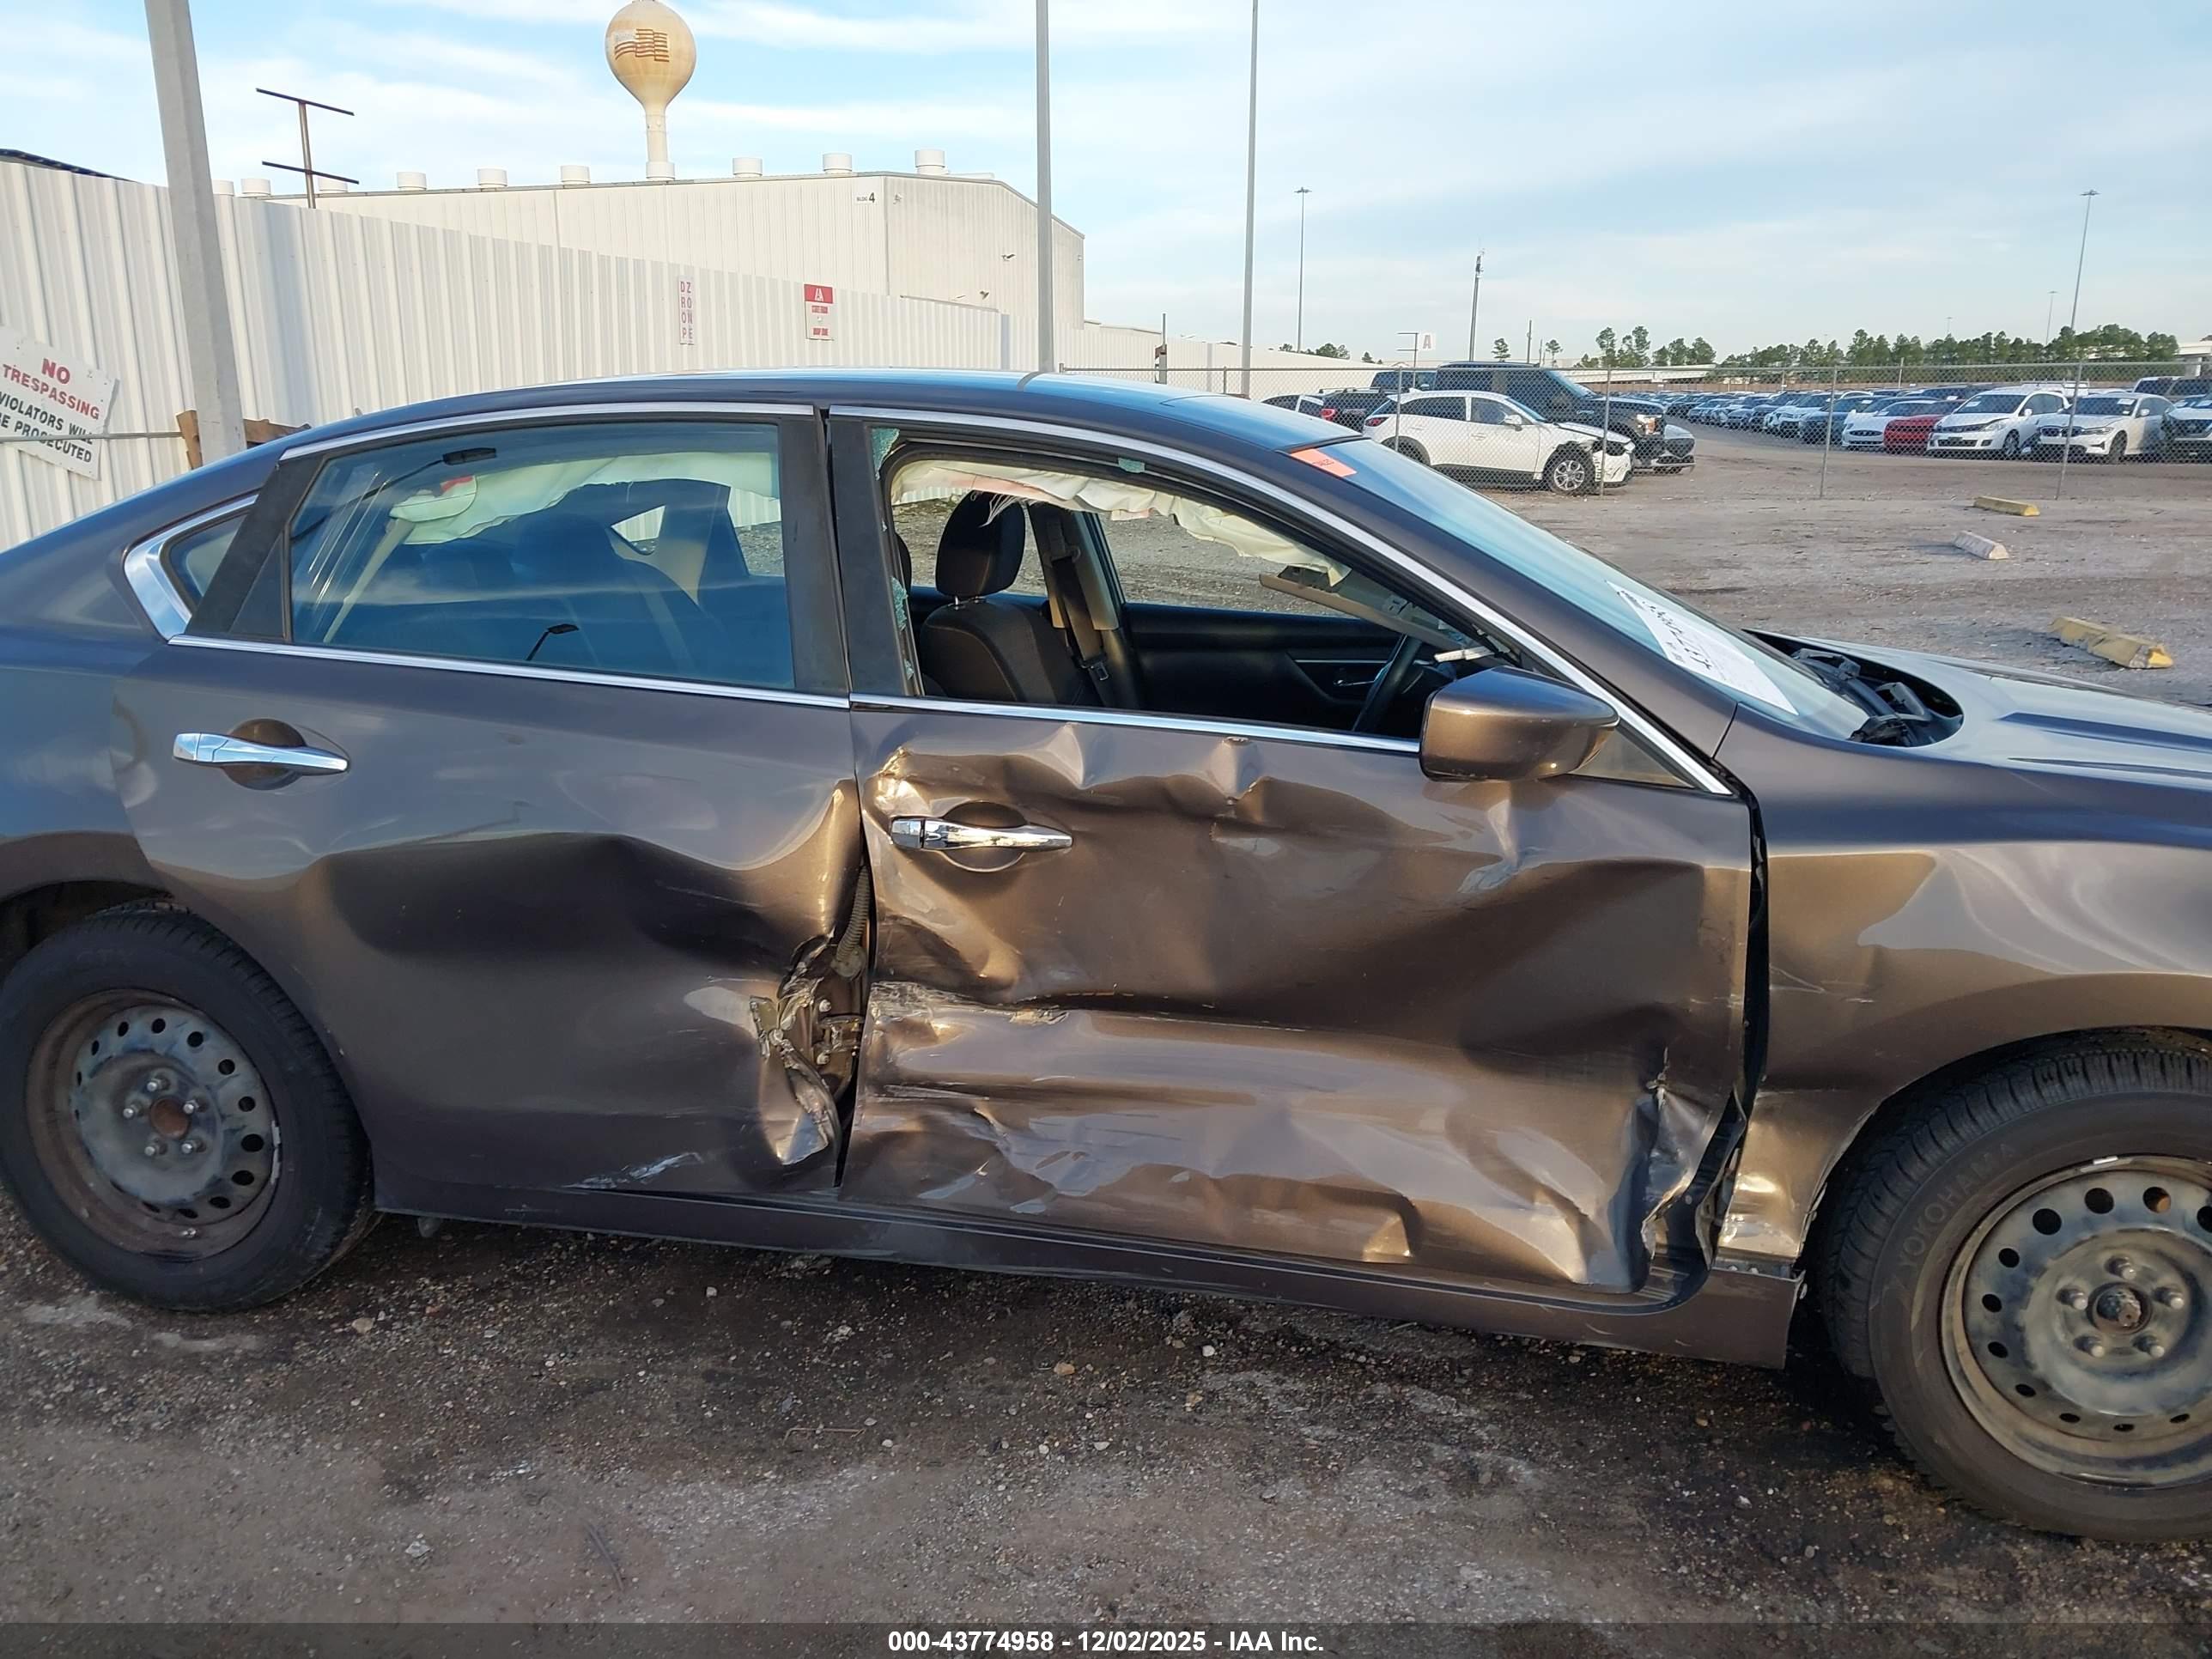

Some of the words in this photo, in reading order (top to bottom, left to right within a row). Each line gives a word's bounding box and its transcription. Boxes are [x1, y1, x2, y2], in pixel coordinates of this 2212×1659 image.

[869, 192, 875, 203] 4
[1422, 334, 1431, 349] A
[41, 357, 70, 385] NO
[3, 363, 100, 420] TRESPASSING
[0, 392, 64, 431] VIOLATORS
[0, 413, 11, 428] E
[1898, 1143, 2015, 1270] YOKOHAMA
